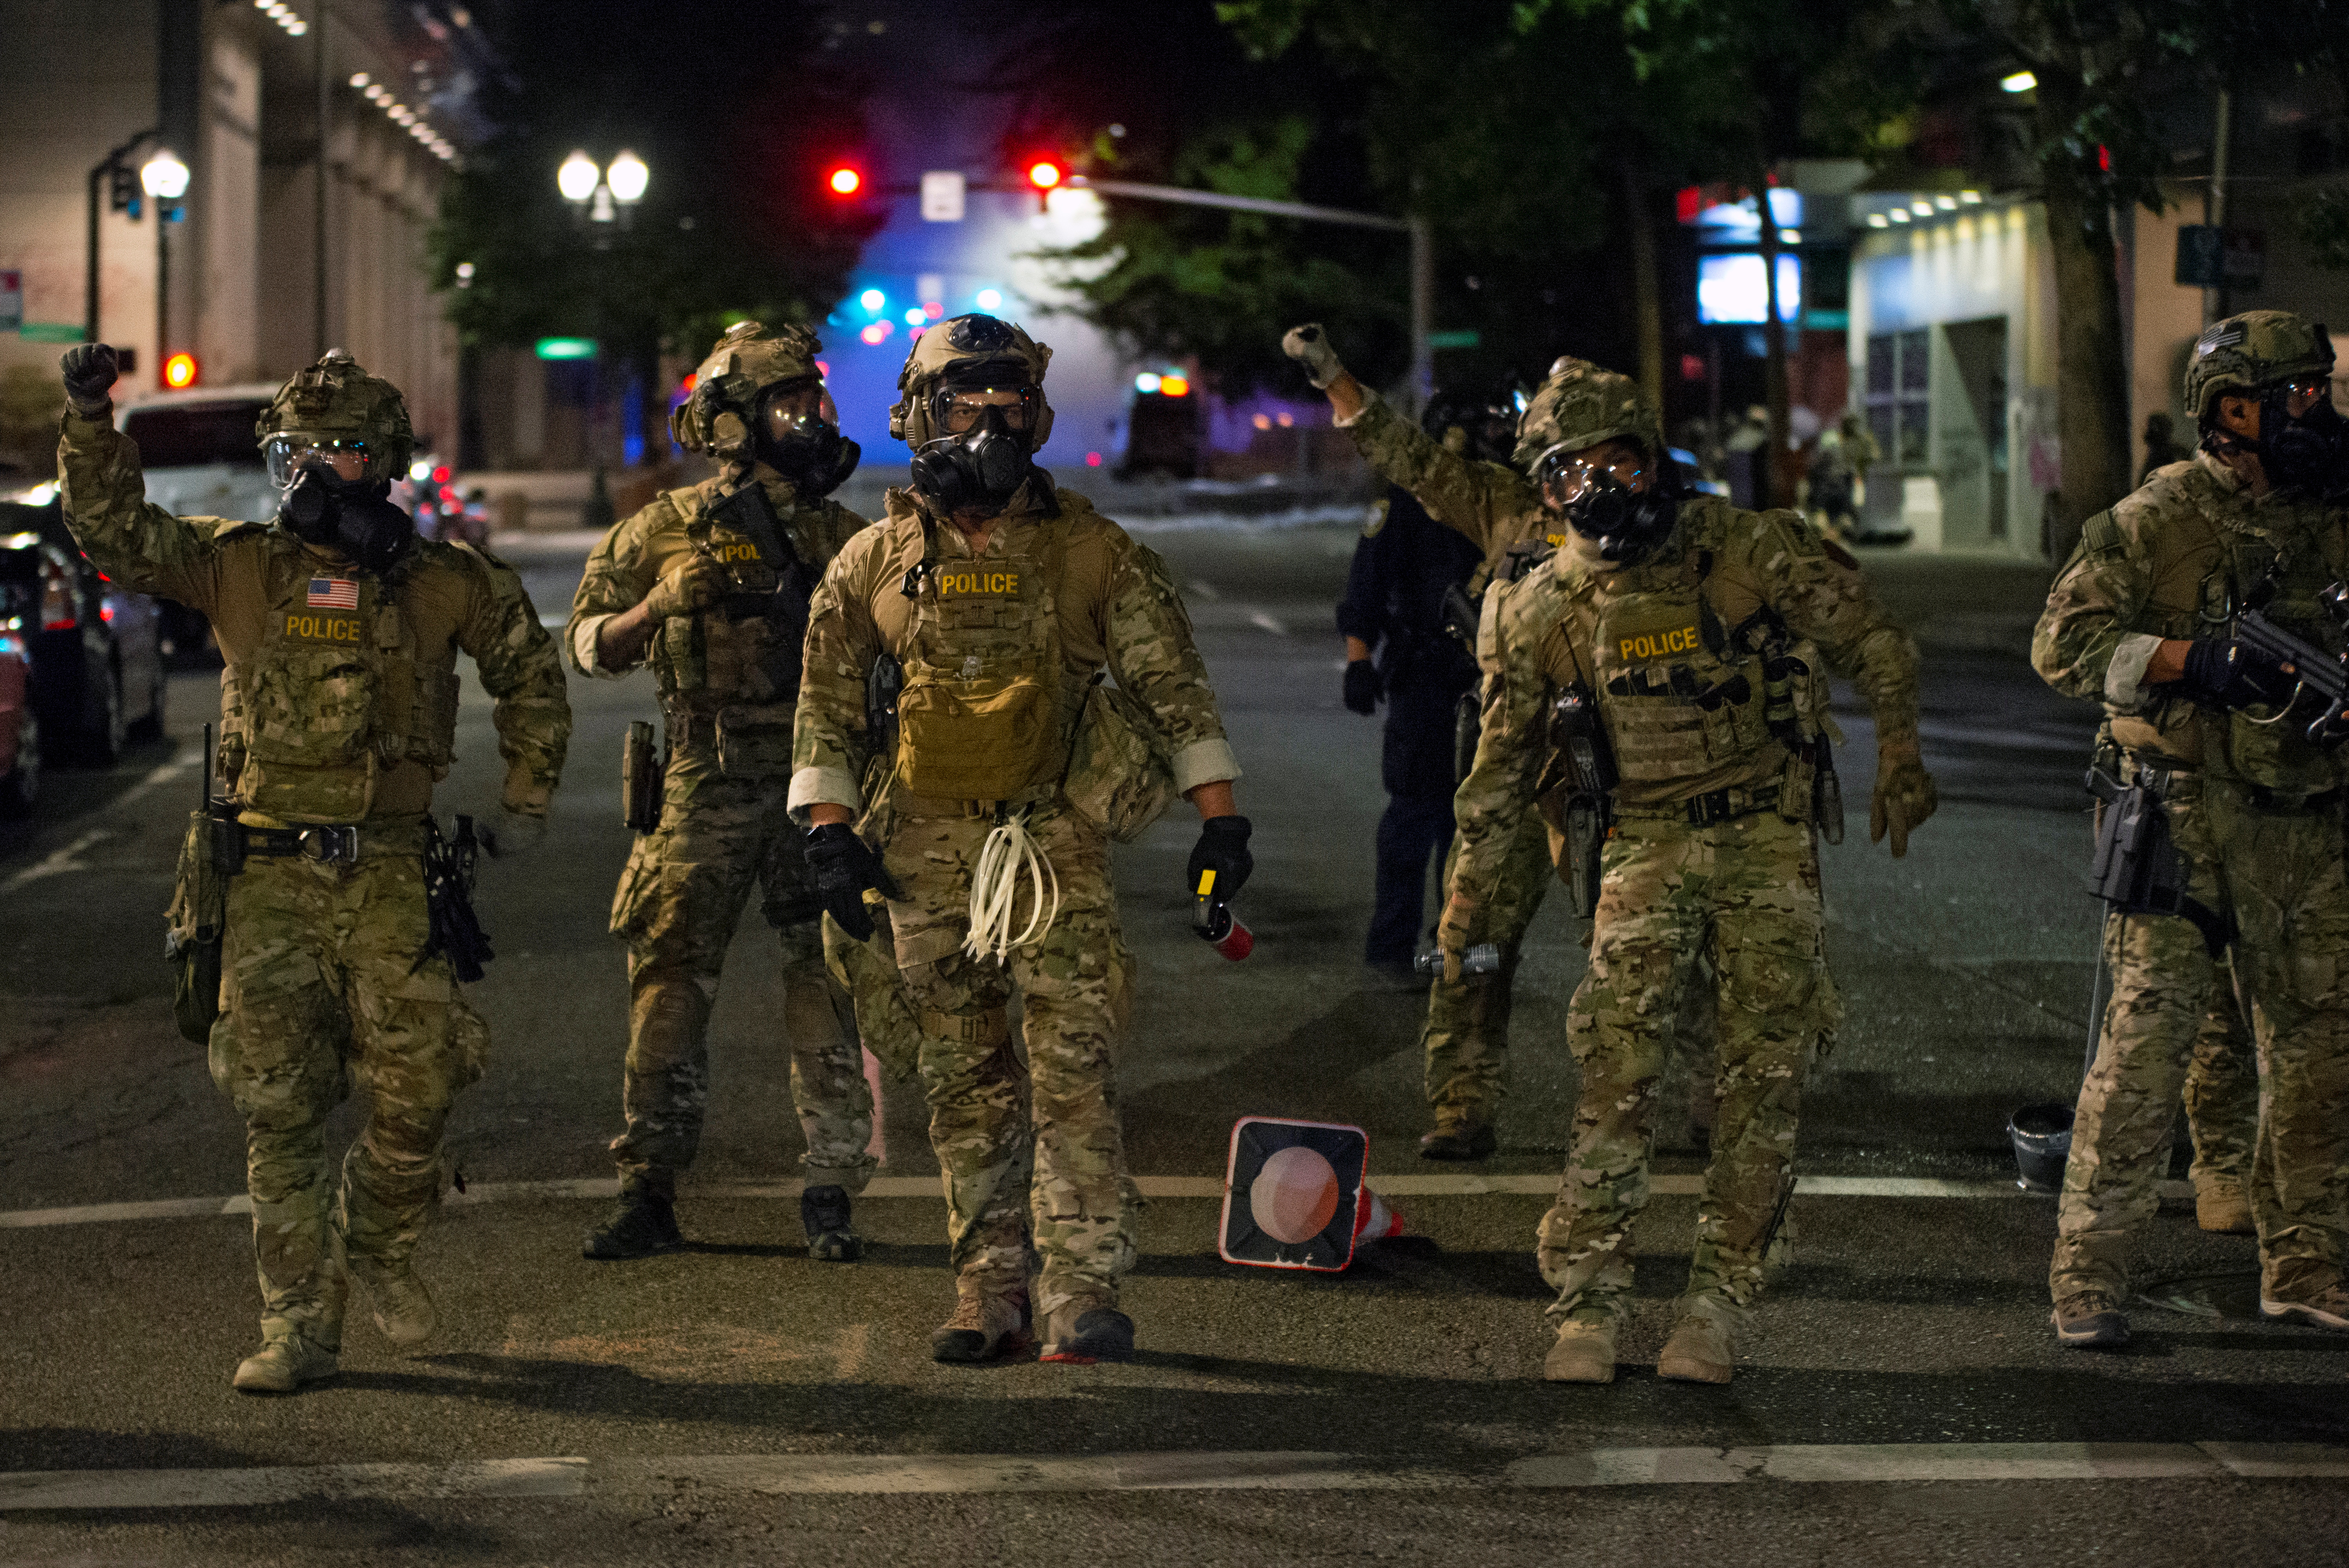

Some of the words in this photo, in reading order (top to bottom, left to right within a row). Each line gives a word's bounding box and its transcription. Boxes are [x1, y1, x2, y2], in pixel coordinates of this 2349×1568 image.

[725, 543, 761, 561] POL
[942, 574, 1018, 594] POLICE
[286, 616, 360, 641] POLICE
[1620, 626, 1698, 660] POLICE
